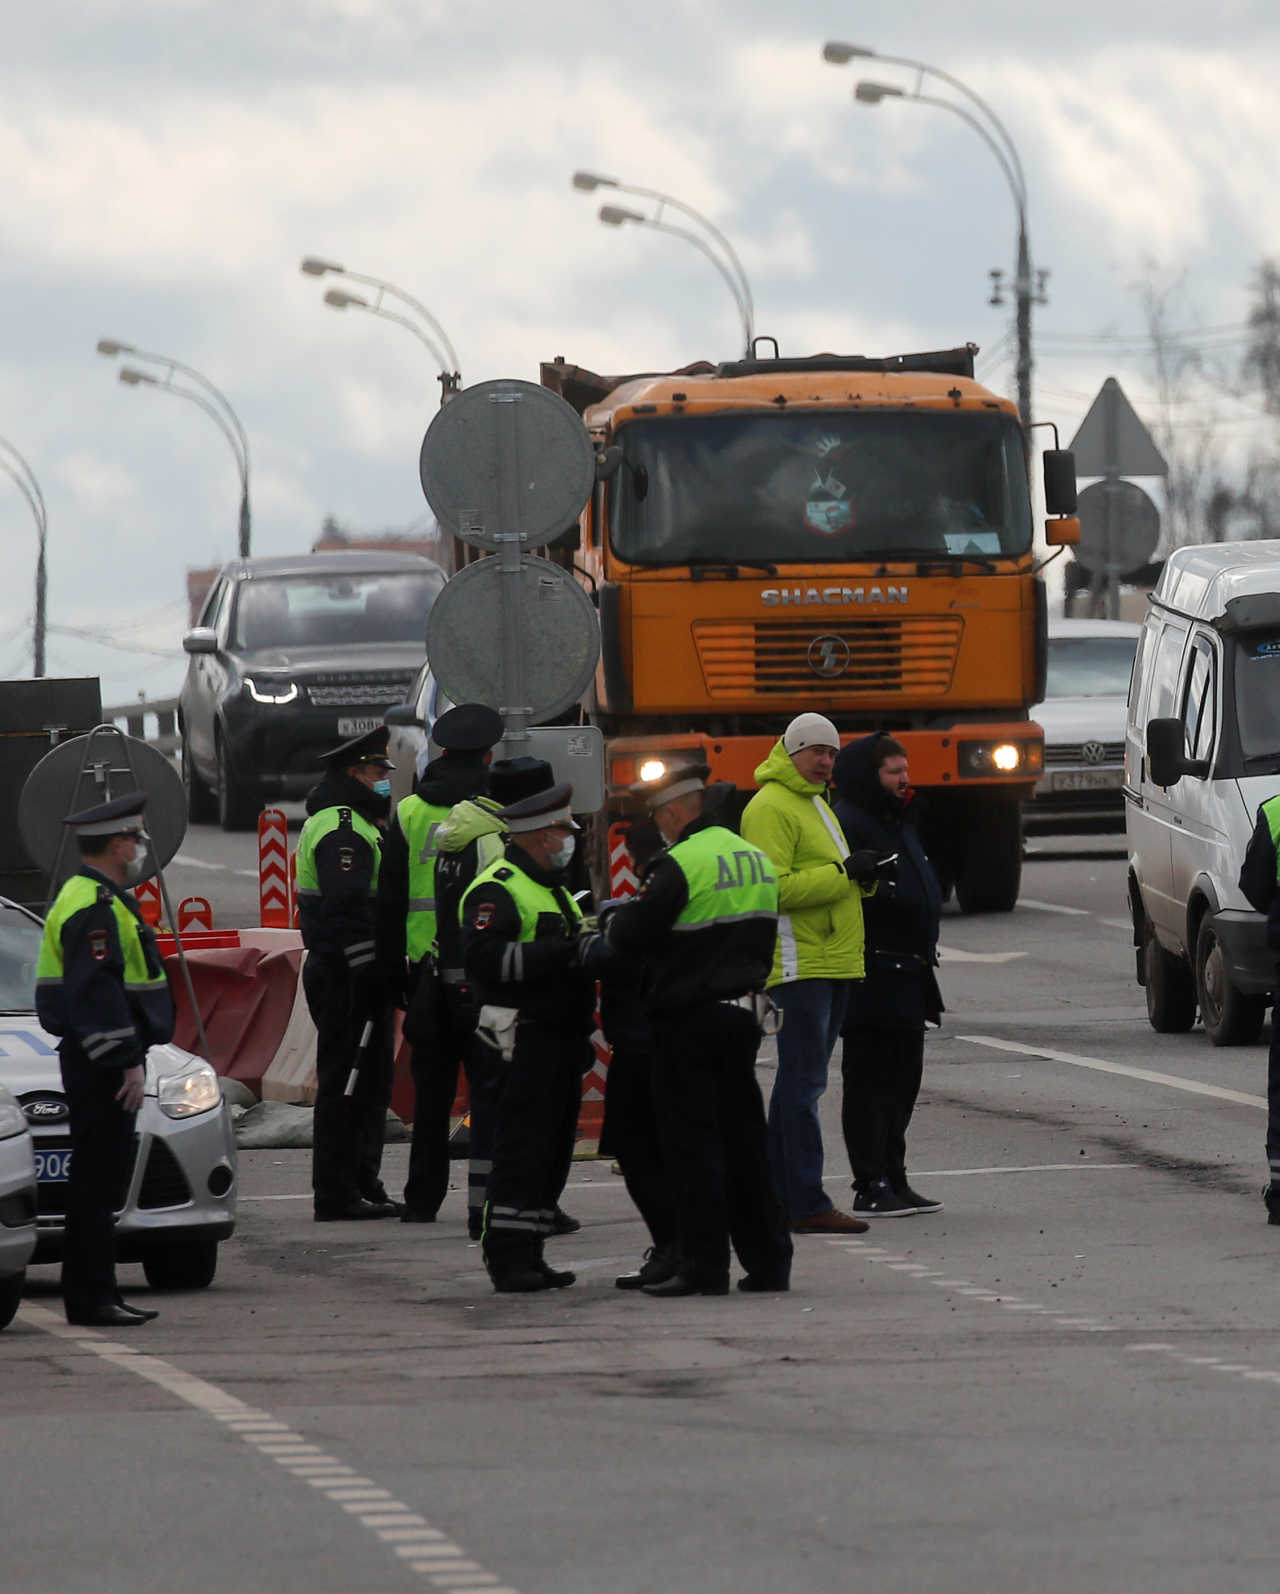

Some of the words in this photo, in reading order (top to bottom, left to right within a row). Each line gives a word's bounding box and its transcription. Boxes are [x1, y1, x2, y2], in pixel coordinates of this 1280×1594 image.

[760, 586, 909, 607] SHACMAN
[715, 851, 776, 891] ДПС
[32, 1103, 61, 1115] Ford
